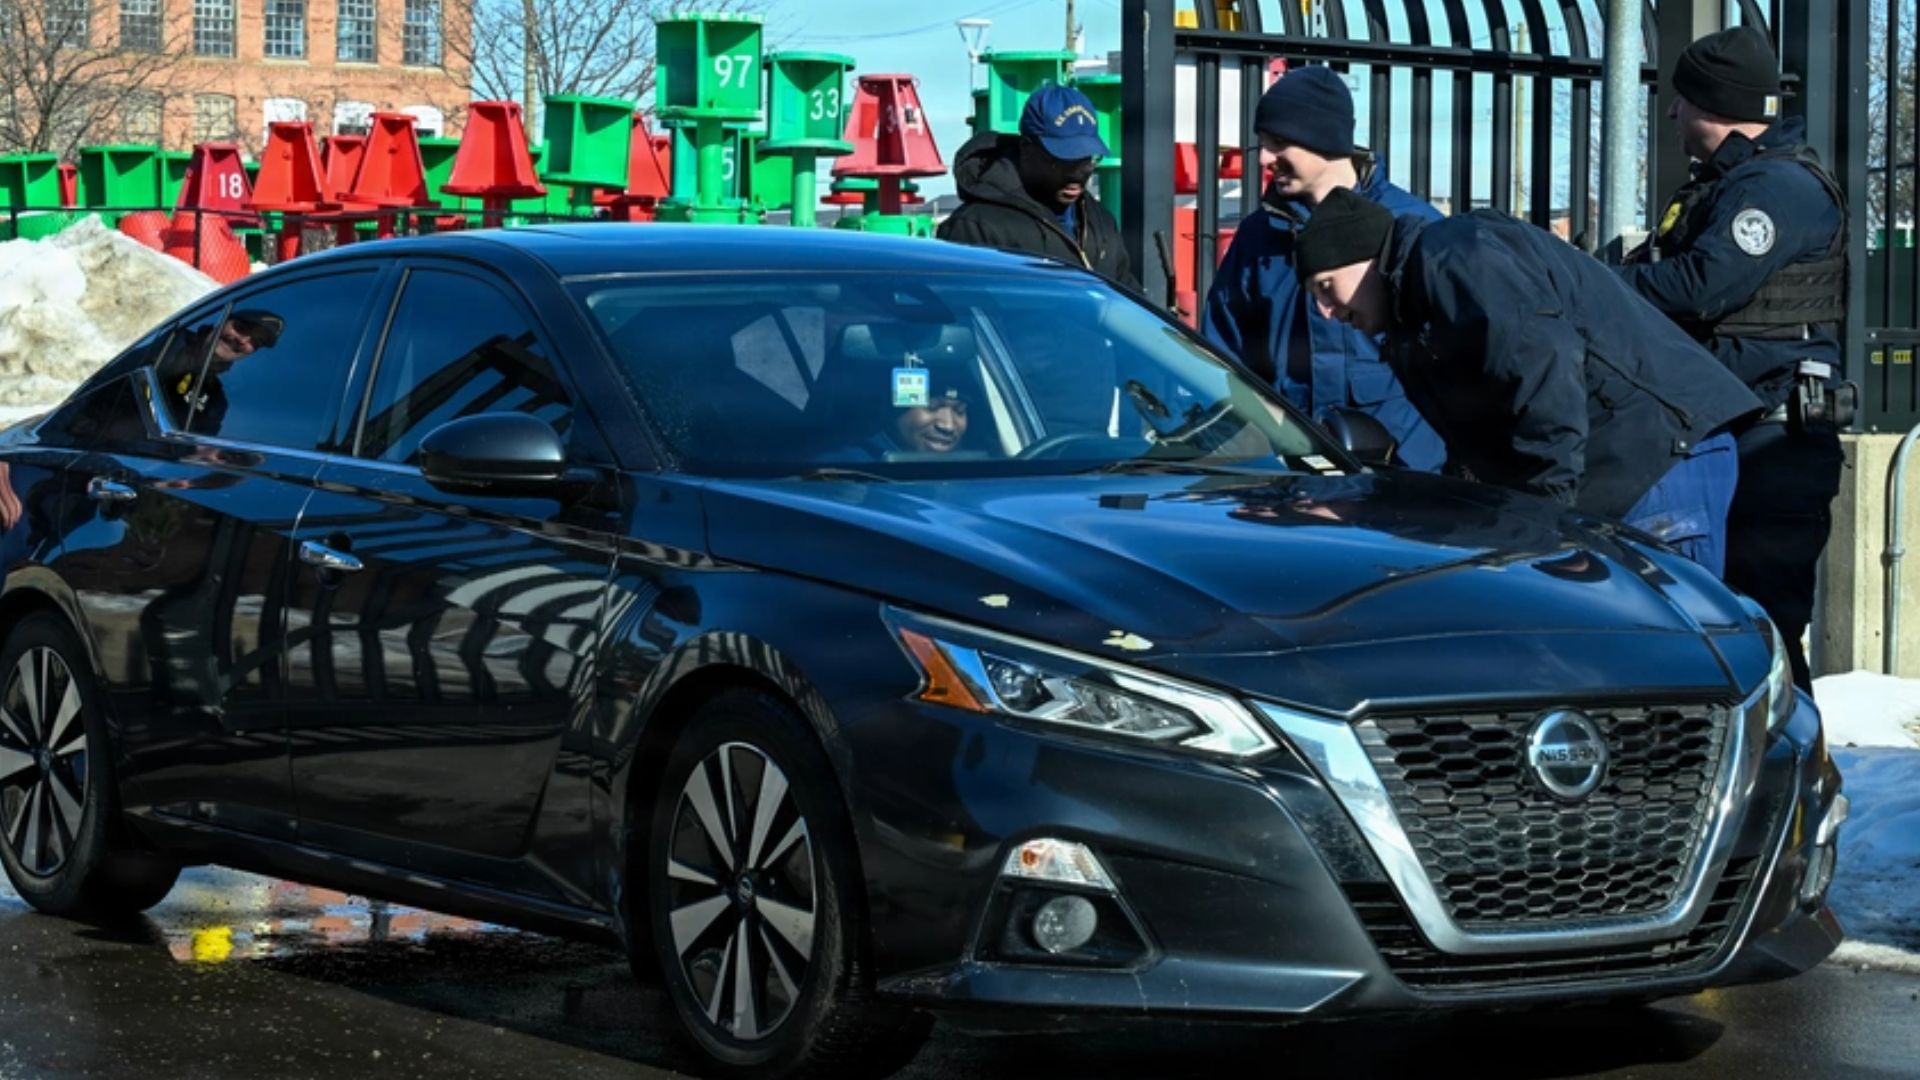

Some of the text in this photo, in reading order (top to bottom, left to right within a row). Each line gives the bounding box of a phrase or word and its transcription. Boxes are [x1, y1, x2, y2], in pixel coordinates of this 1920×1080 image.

[714, 55, 752, 89] 97
[810, 88, 840, 120] 33
[721, 147, 734, 181] 5
[219, 173, 243, 199] 18
